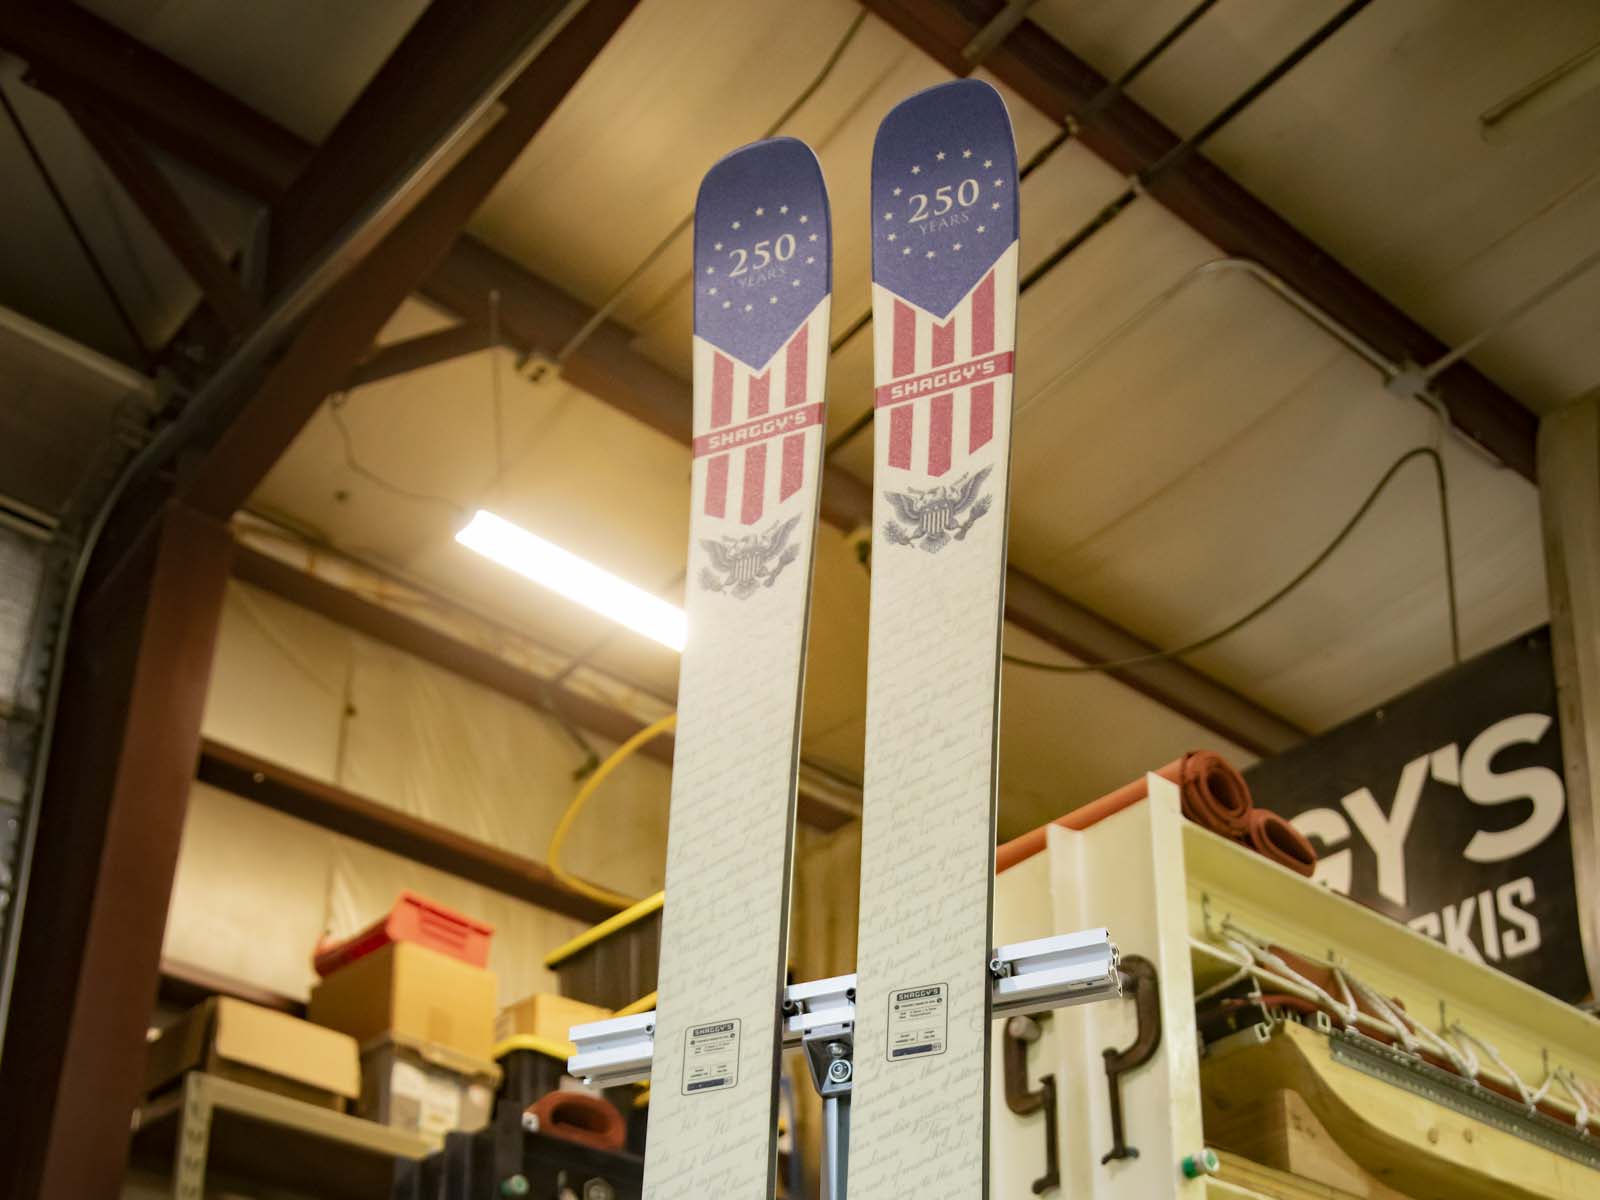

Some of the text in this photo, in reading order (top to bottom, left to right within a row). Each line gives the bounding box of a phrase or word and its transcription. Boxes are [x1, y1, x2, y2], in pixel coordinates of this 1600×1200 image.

[907, 179, 980, 224] 250
[919, 212, 970, 236] YEARS
[728, 233, 797, 278] 250
[737, 266, 787, 289] YEARS
[890, 360, 995, 400] SHAGGY'S
[708, 411, 807, 449] SHAGGY'S
